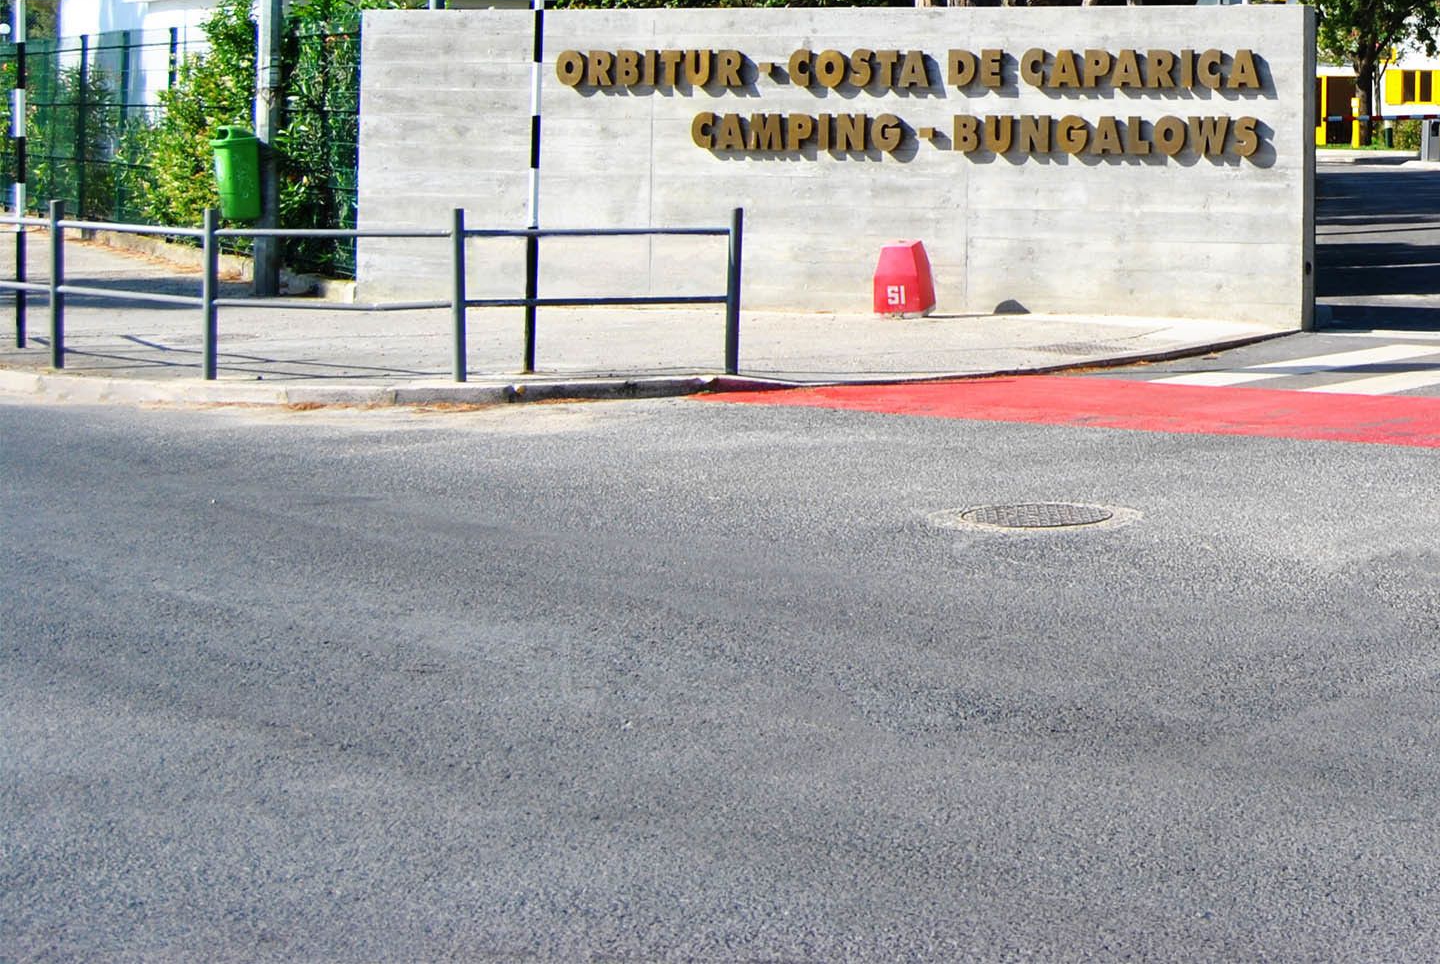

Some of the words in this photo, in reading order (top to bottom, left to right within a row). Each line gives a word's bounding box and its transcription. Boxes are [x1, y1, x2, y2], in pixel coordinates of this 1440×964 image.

[556, 49, 745, 86] ORBITUR
[788, 48, 930, 87] COSTA
[948, 49, 1003, 86] DE
[1020, 48, 1261, 88] CAPARICA
[691, 111, 903, 152] CAMPING
[953, 114, 1259, 157] BUNGALOWS
